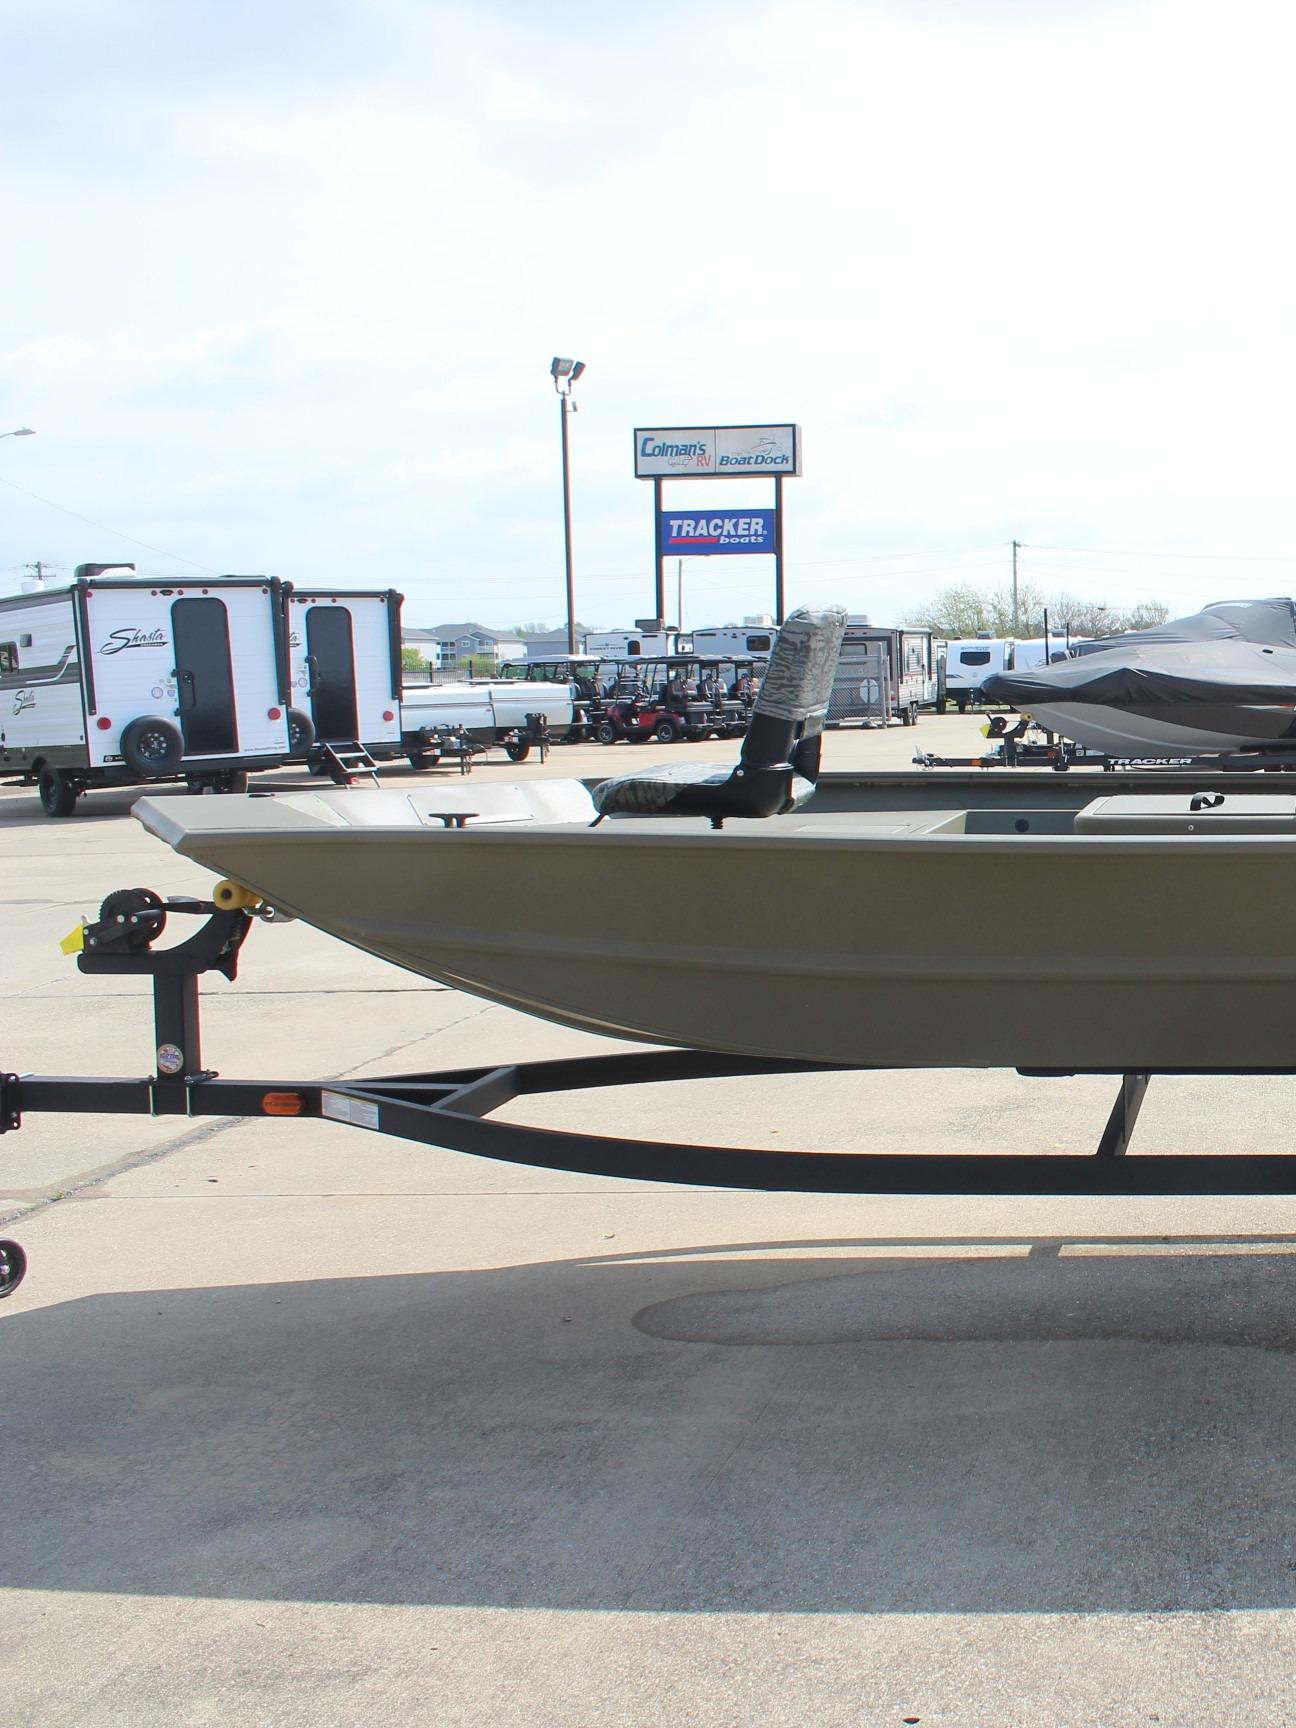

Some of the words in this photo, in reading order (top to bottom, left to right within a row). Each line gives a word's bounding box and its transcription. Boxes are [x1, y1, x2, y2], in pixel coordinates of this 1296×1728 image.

[641, 436, 707, 458] Colman's
[696, 455, 712, 467] RV
[669, 517, 764, 537] TRACKER
[720, 536, 764, 544] boats
[98, 628, 166, 656] Shasta
